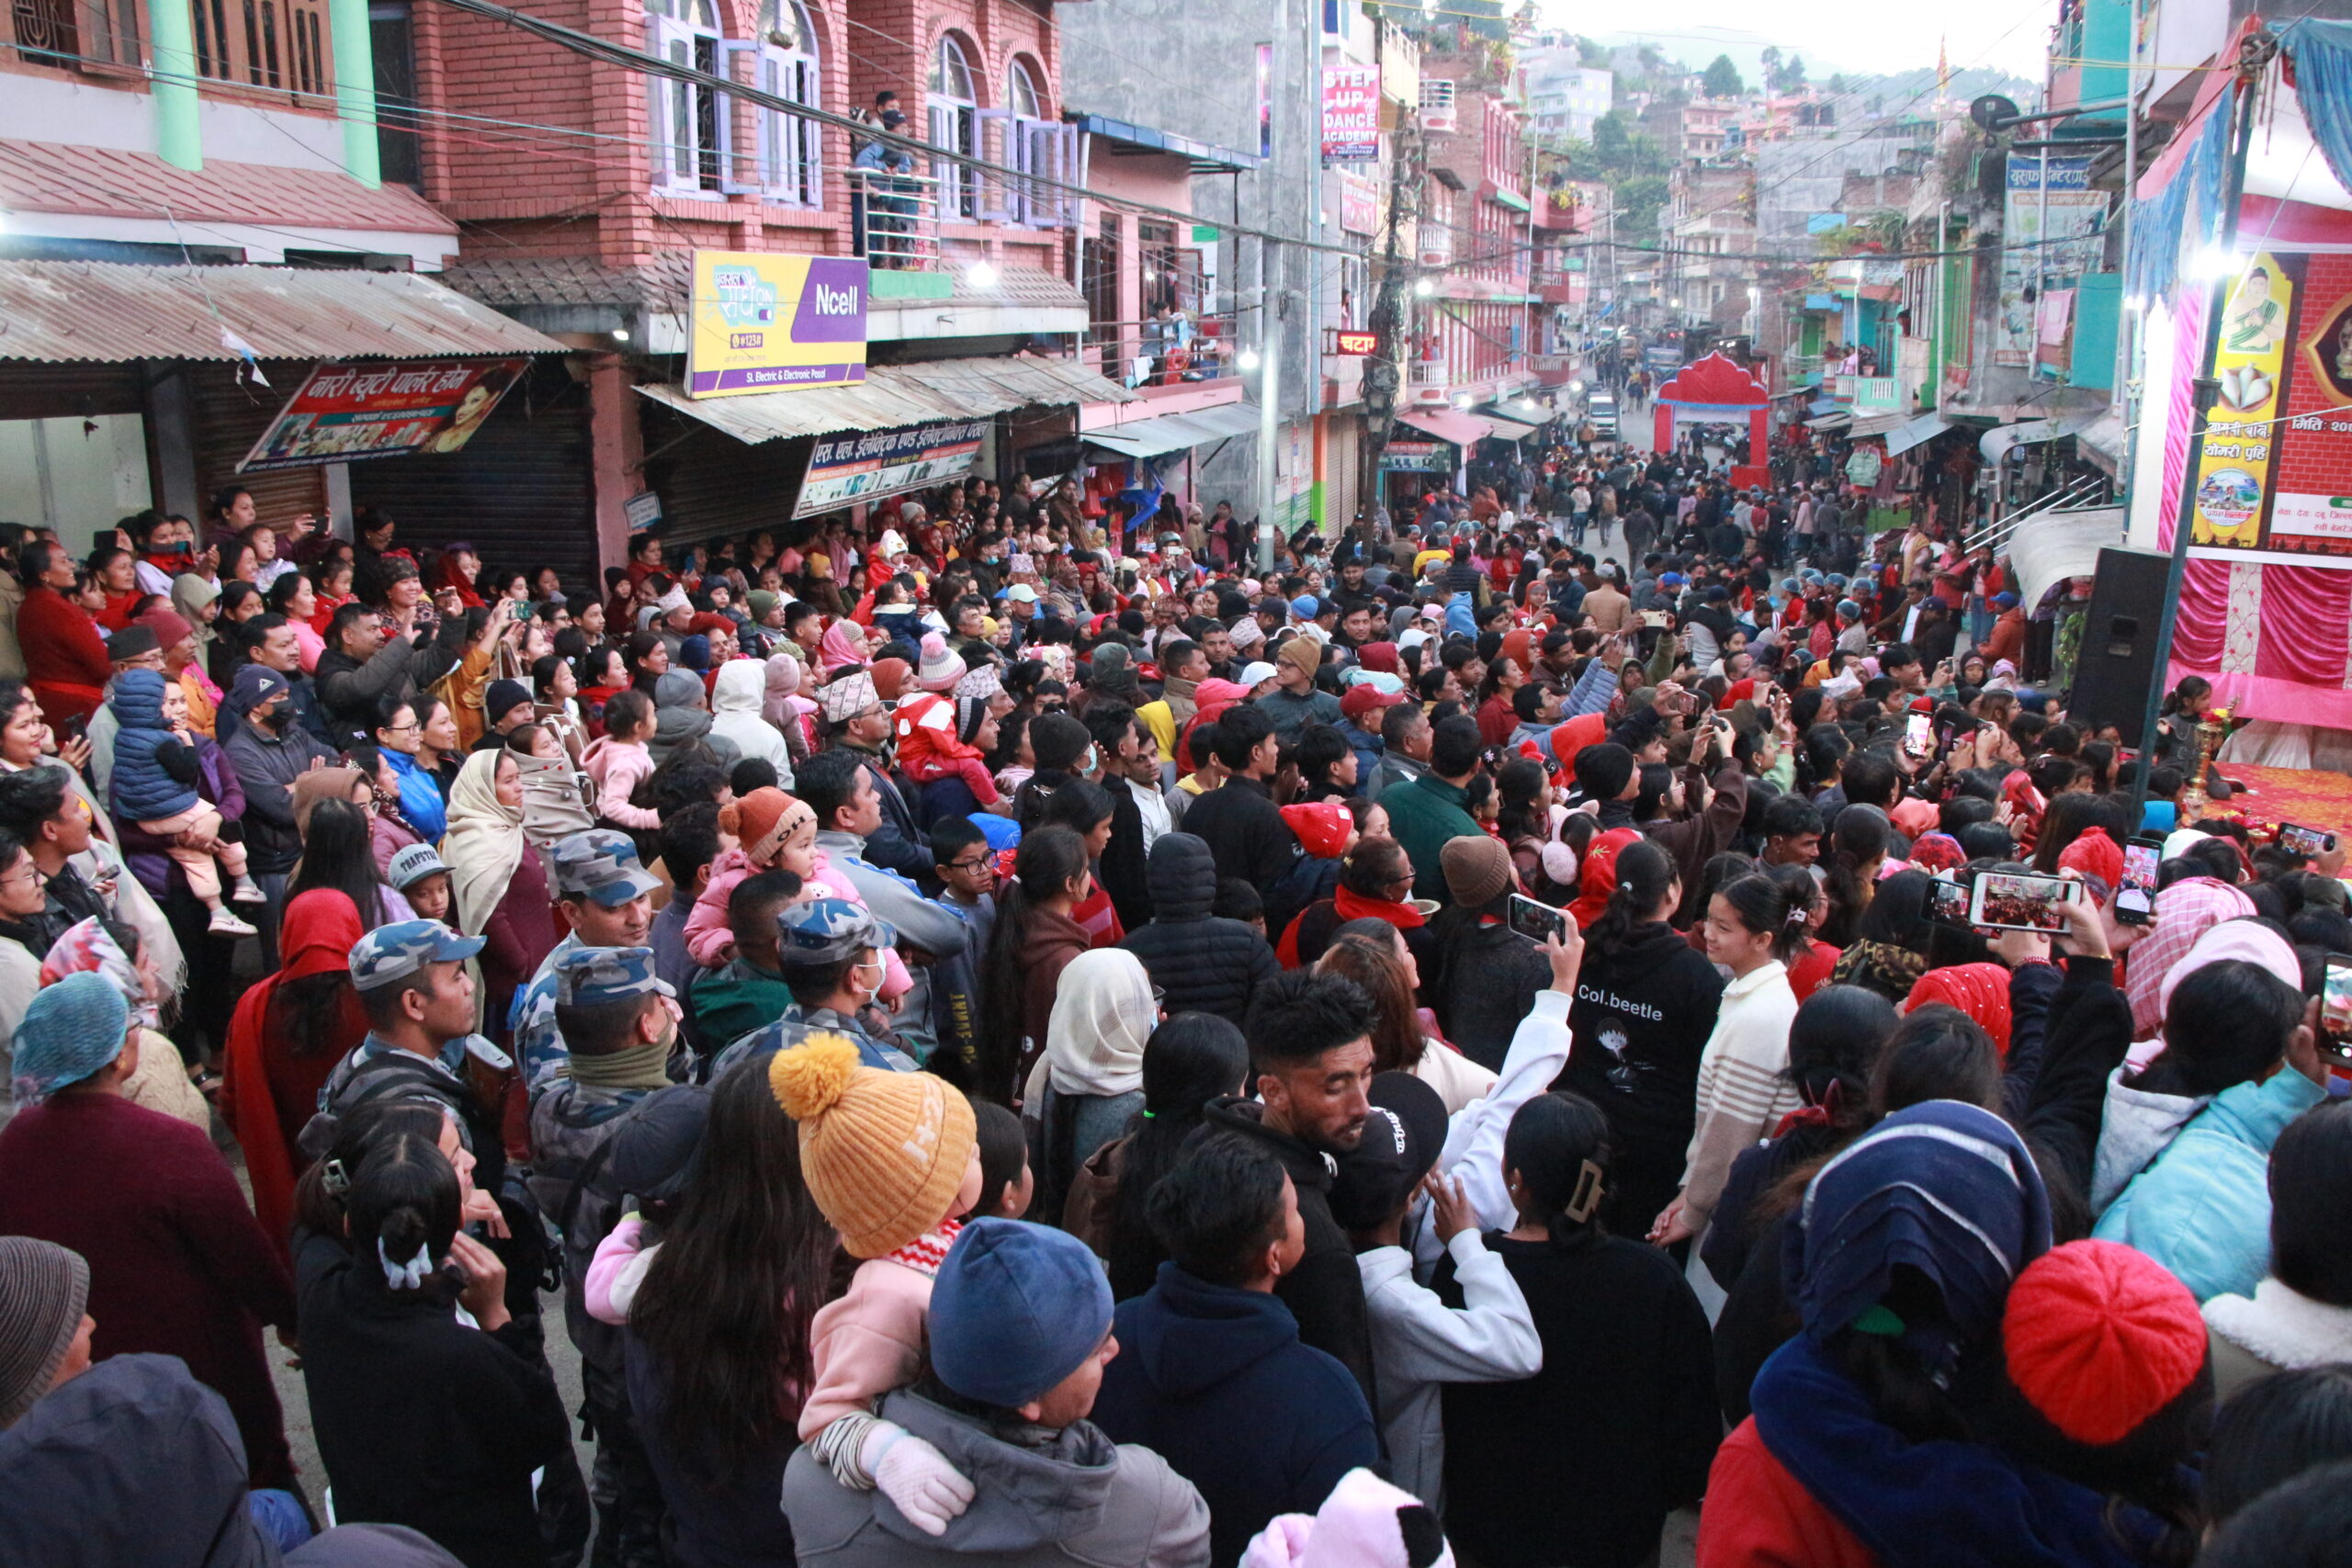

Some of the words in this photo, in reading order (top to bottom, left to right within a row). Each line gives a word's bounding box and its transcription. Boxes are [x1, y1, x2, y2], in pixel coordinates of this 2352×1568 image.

[1336, 91, 1363, 107] UP
[1323, 113, 1376, 128] DANCE
[1323, 130, 1377, 142] ACADEMY
[816, 284, 858, 316] Ncell
[755, 370, 777, 382] Electric
[784, 368, 810, 380] Electronic
[811, 367, 826, 379] Pasal
[1578, 984, 1663, 1021] Col.beetle
